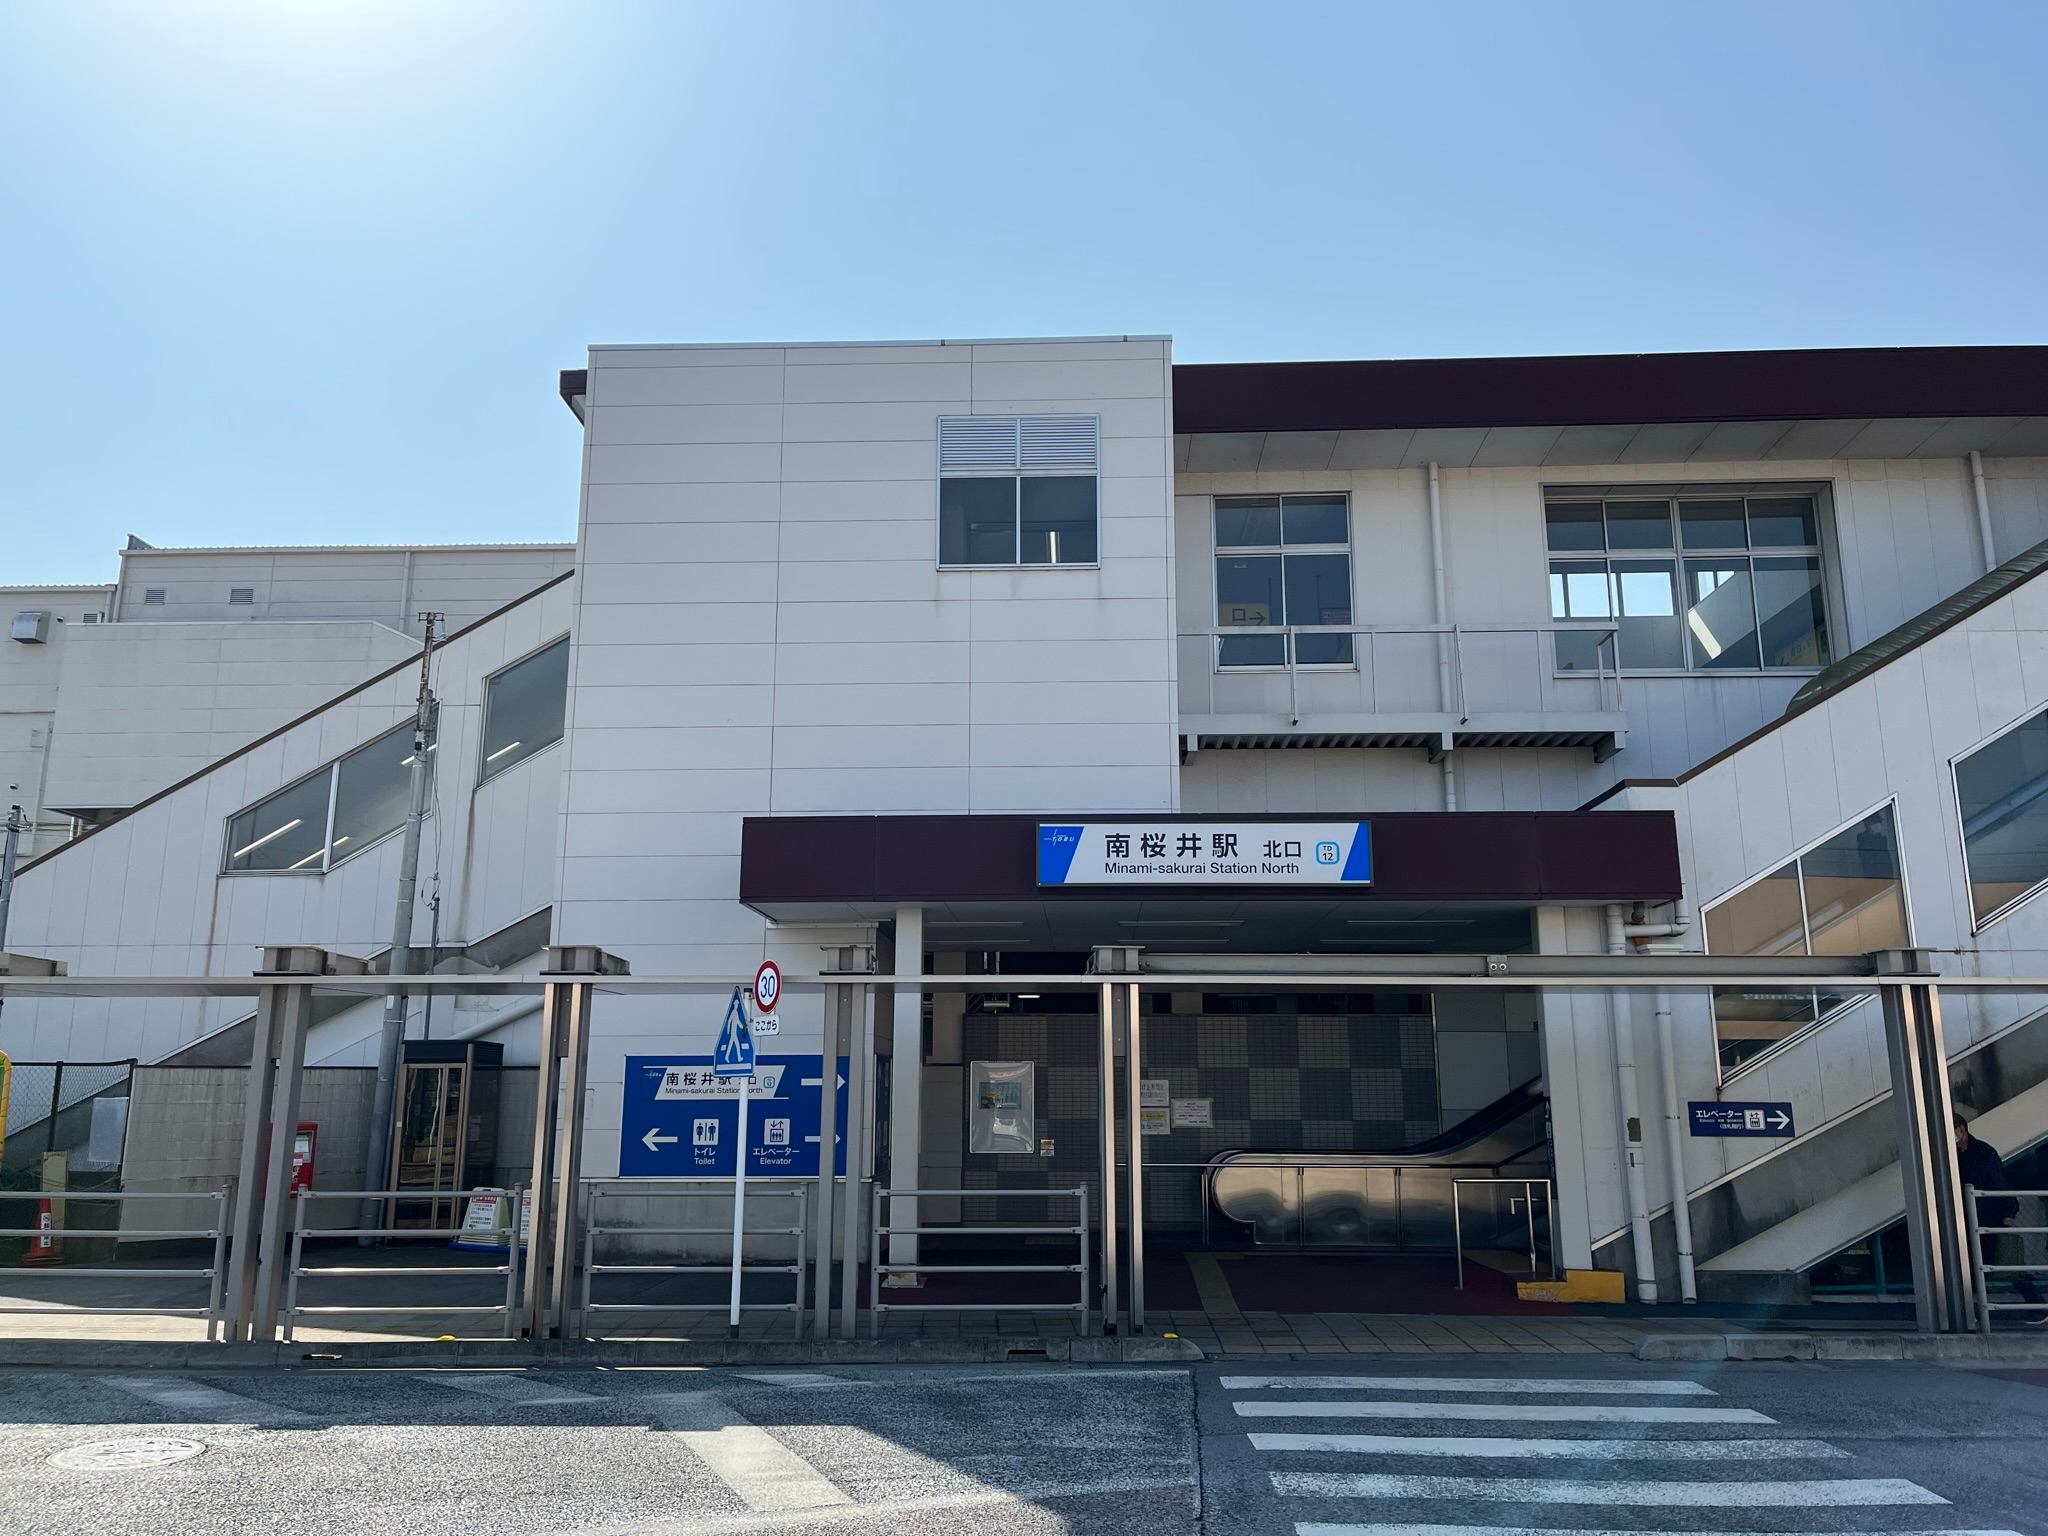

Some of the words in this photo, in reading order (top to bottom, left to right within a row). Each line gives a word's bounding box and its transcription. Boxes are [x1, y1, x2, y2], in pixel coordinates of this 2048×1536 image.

[1104, 832, 1239, 858] 南桜井駅
[1263, 840, 1302, 858] 北口
[1322, 852, 1334, 861] 12
[1104, 862, 1206, 874] Minami-sakurai
[1210, 862, 1257, 874] Station
[1262, 862, 1299, 874] North
[760, 975, 775, 998] 30
[755, 1020, 777, 1031] ここから
[1695, 1110, 1743, 1118] エレベーター
[752, 1147, 800, 1155] エレベーター
[694, 1157, 715, 1165] Toilet
[760, 1157, 792, 1165] Elevator
